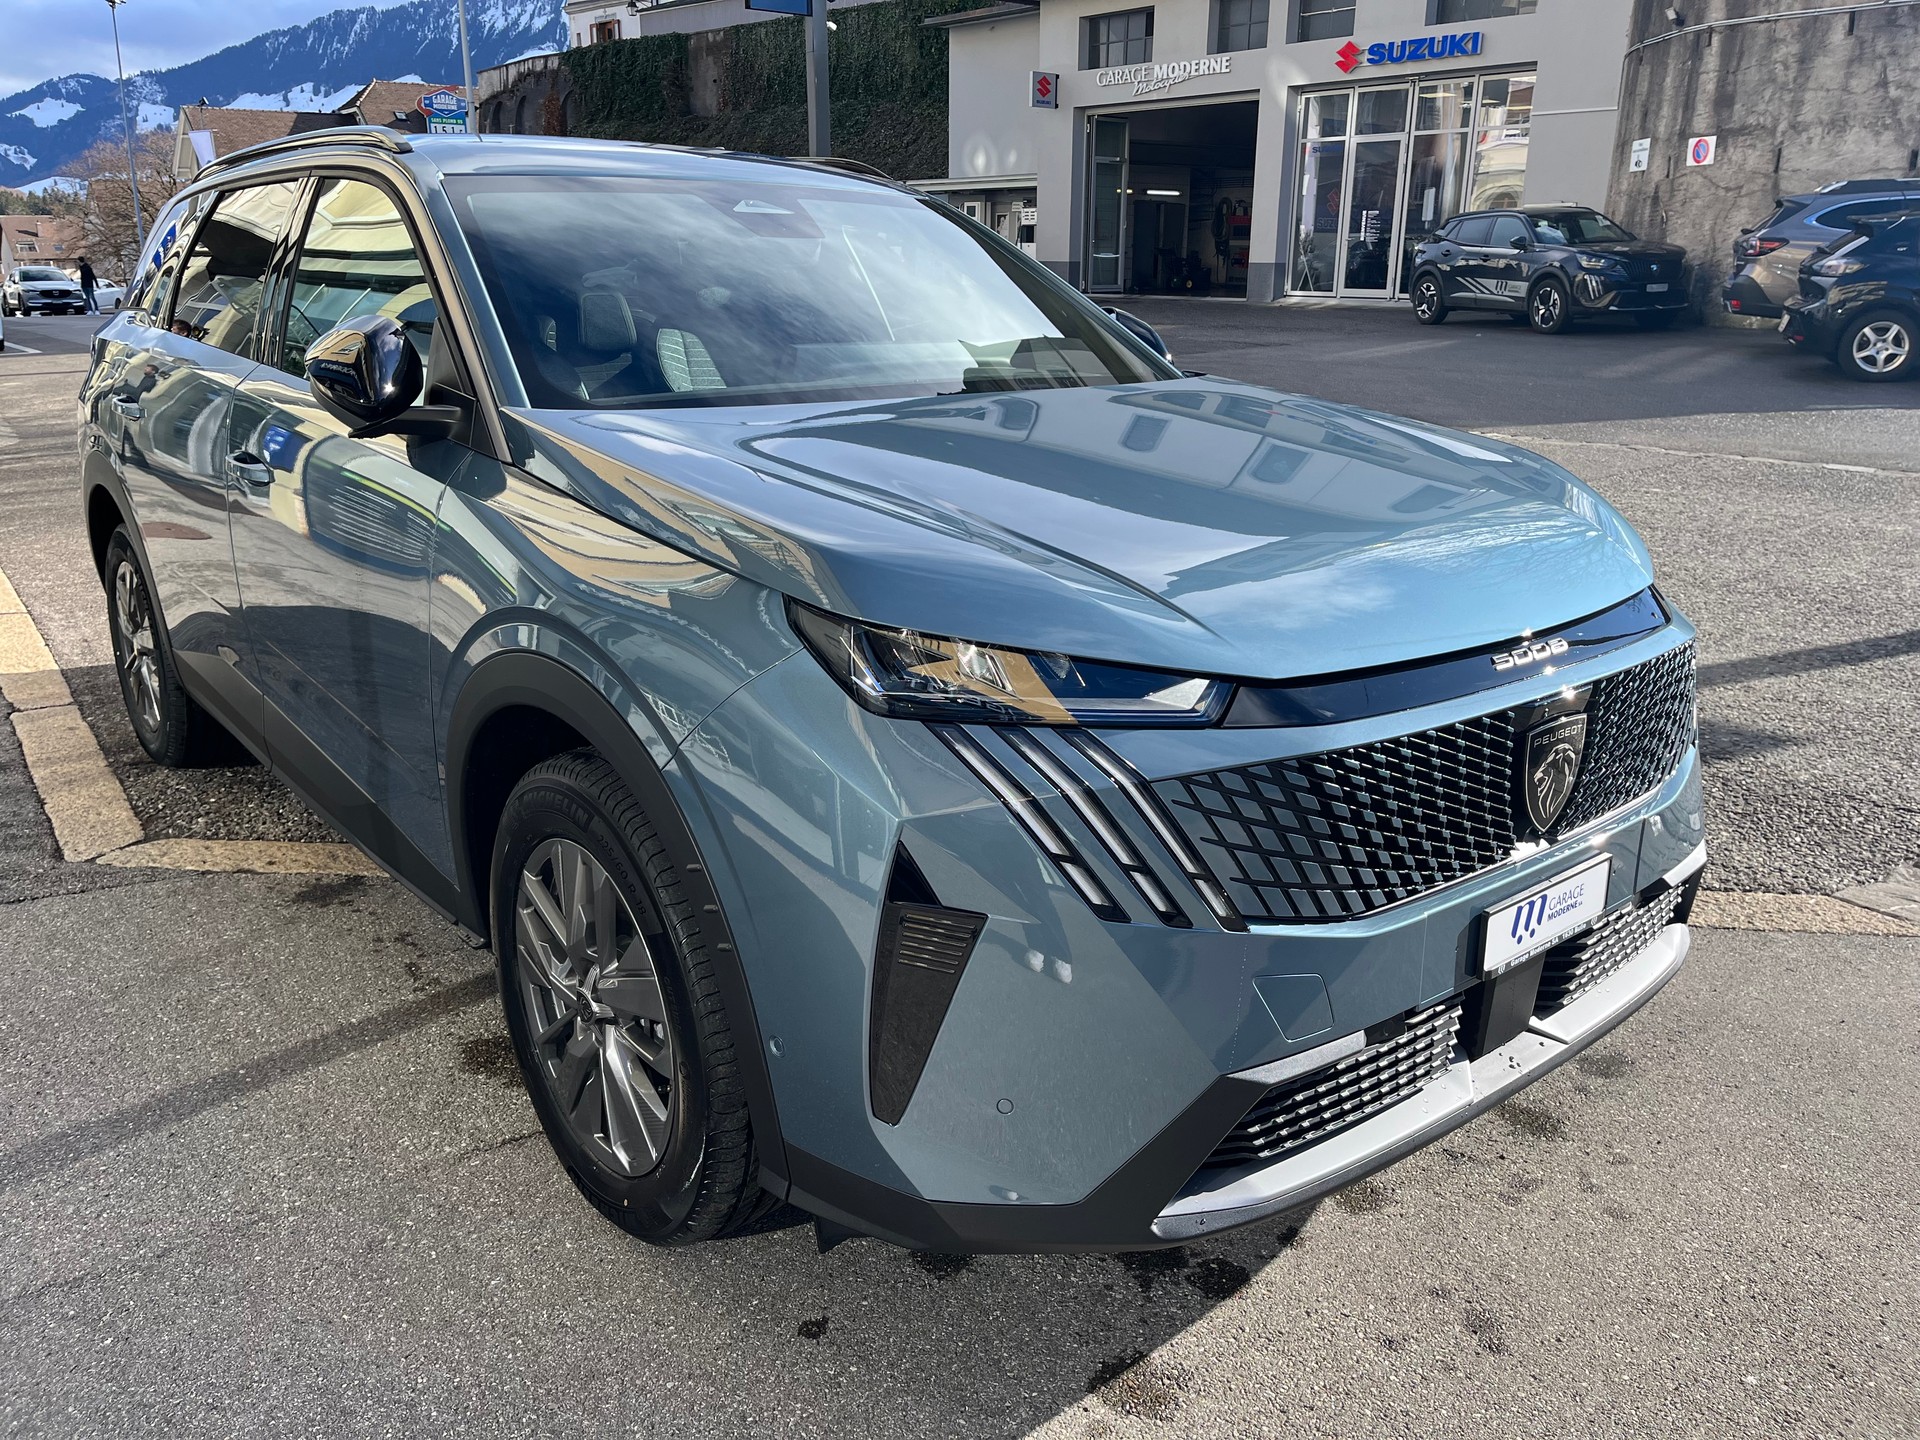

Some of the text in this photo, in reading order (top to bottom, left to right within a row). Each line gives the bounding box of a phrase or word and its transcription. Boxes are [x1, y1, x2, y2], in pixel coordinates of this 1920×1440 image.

[1366, 31, 1483, 65] SUZUKI
[1096, 56, 1231, 86] GARAGE MODERNE
[432, 94, 457, 105] GARAGE
[1490, 637, 1569, 671] 5008
[1533, 724, 1583, 748] PEUGEOT
[522, 790, 590, 828] MICHELIN
[597, 834, 629, 880] 225/60
[627, 883, 637, 896] R
[1547, 900, 1578, 922] MODERNE
[1548, 883, 1585, 911] GARAGE
[1510, 952, 1529, 967] Garage
[1529, 941, 1551, 957] Moderne
[1551, 937, 1559, 946] SA
